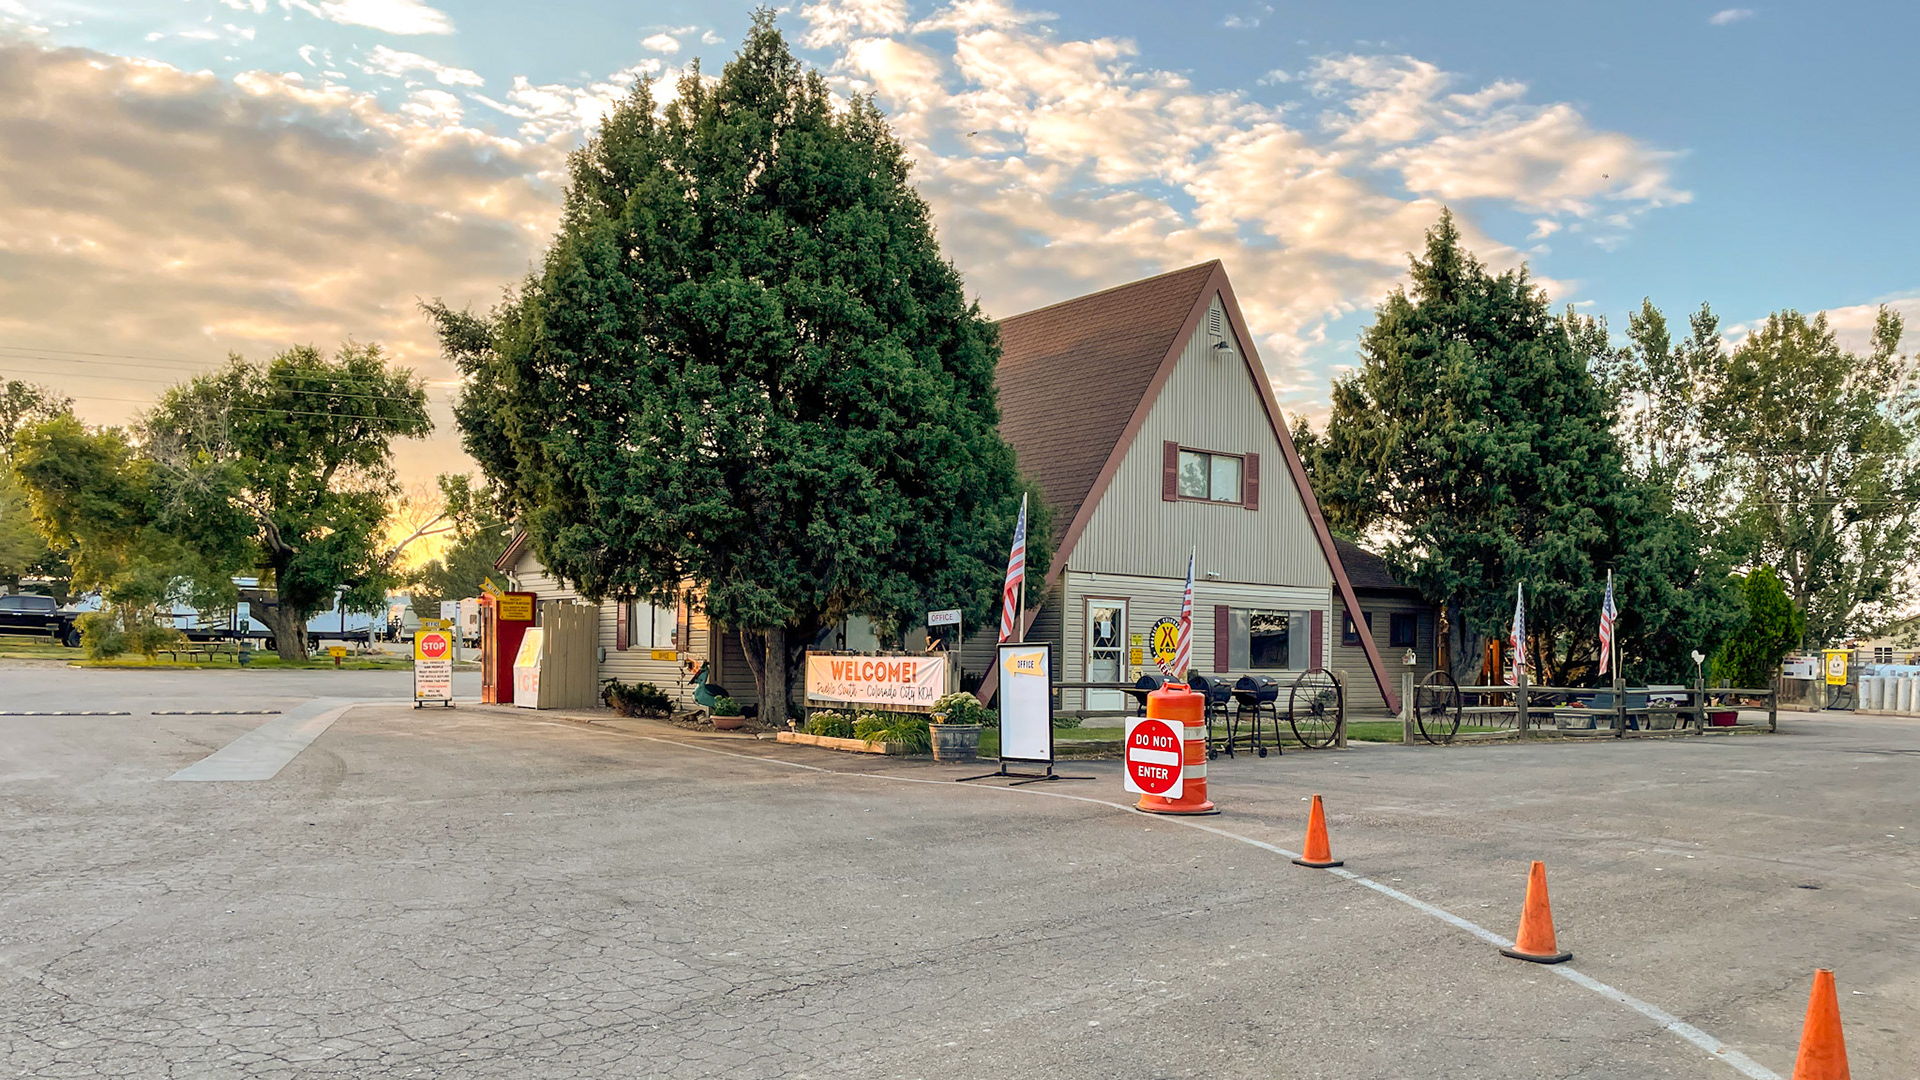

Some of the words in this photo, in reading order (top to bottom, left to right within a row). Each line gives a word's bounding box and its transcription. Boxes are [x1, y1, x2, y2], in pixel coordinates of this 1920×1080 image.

[931, 613, 953, 622] OFFICE
[422, 642, 445, 650] STOP
[830, 660, 917, 683] WELCOME!
[1017, 660, 1034, 668] OFFICE
[517, 674, 539, 692] ICE
[816, 682, 836, 695] Pueblo
[837, 683, 857, 698] South
[867, 684, 897, 700] Colorado
[900, 685, 915, 703] City
[918, 686, 934, 700] KOA
[1135, 733, 1149, 746] DO
[1152, 735, 1174, 748] NOT
[1138, 765, 1169, 780] ENTER
